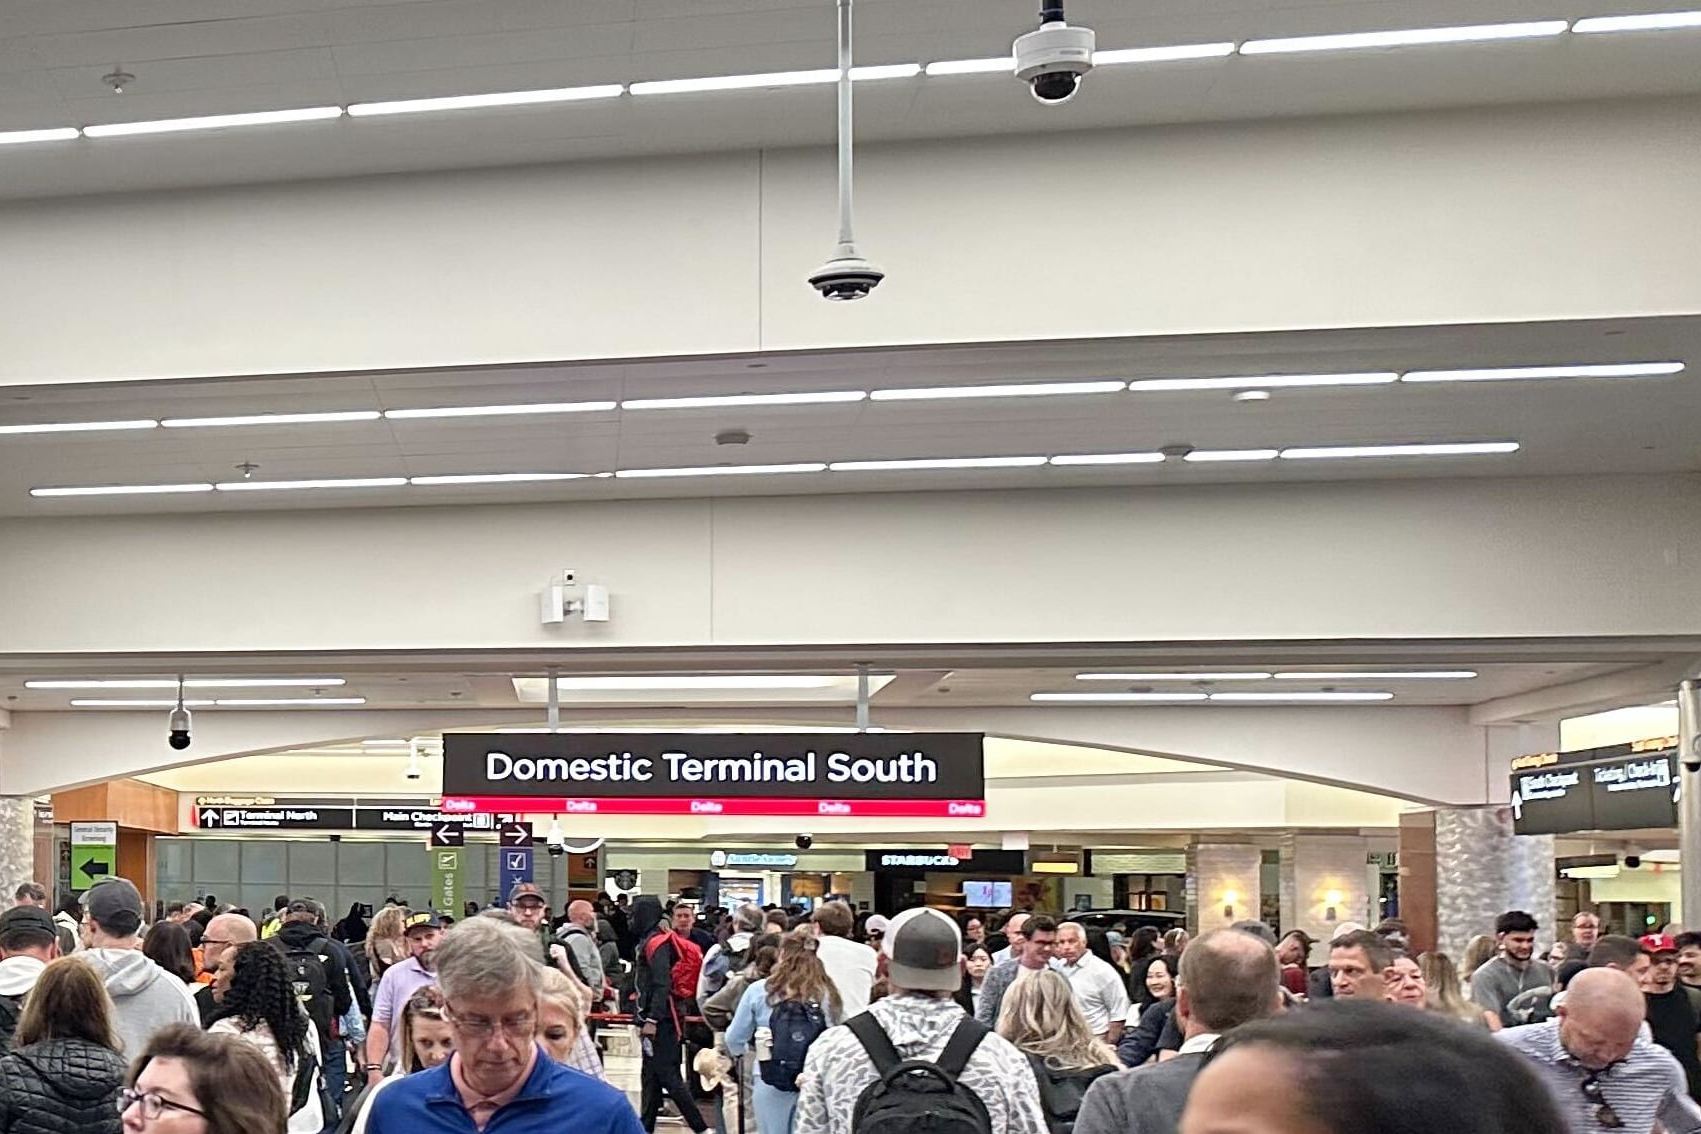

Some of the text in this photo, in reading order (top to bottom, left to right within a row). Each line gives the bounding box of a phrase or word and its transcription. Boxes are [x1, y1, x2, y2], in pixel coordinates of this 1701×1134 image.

[486, 752, 937, 782] Domestic Terminal South
[445, 800, 981, 814] Delta Delta Delta Delta Delta
[239, 810, 318, 820] Terminal North
[383, 811, 473, 823] Main Checkpoint
[881, 855, 960, 866] STARBUCKS
[443, 872, 454, 907] Gates
